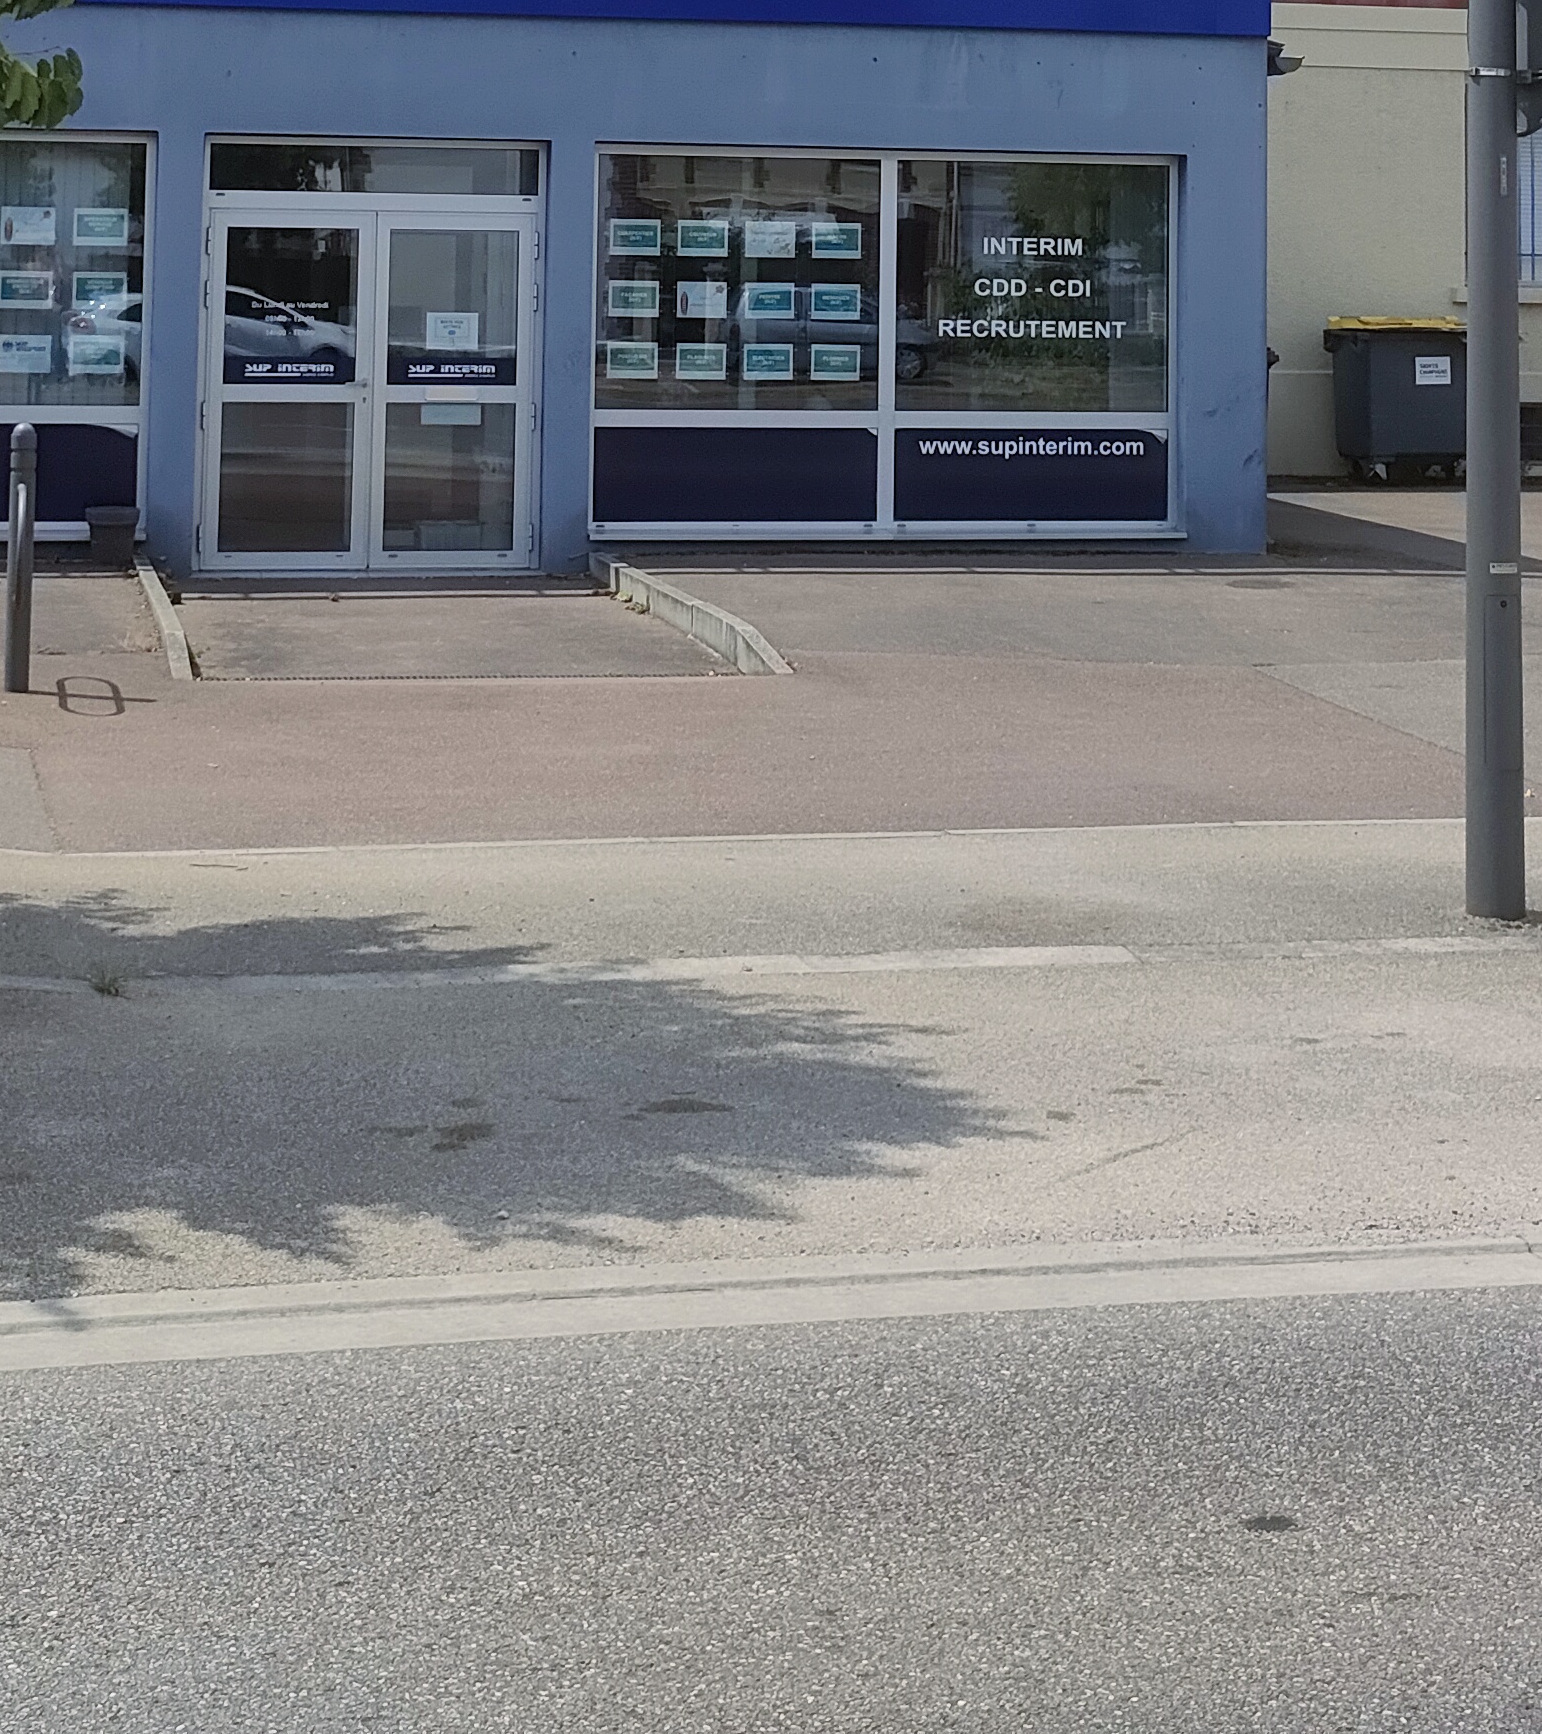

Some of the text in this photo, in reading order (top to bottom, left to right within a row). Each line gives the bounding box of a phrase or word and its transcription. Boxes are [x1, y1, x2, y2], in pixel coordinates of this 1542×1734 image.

[982, 236, 1084, 257] INTERIM
[973, 277, 1028, 298] CDD
[1049, 278, 1092, 298] CDI
[937, 318, 1127, 340] RECRUTEMENT
[244, 363, 273, 373] SUP
[407, 364, 435, 374] SUP
[918, 436, 1145, 460] www.supinterim.com
